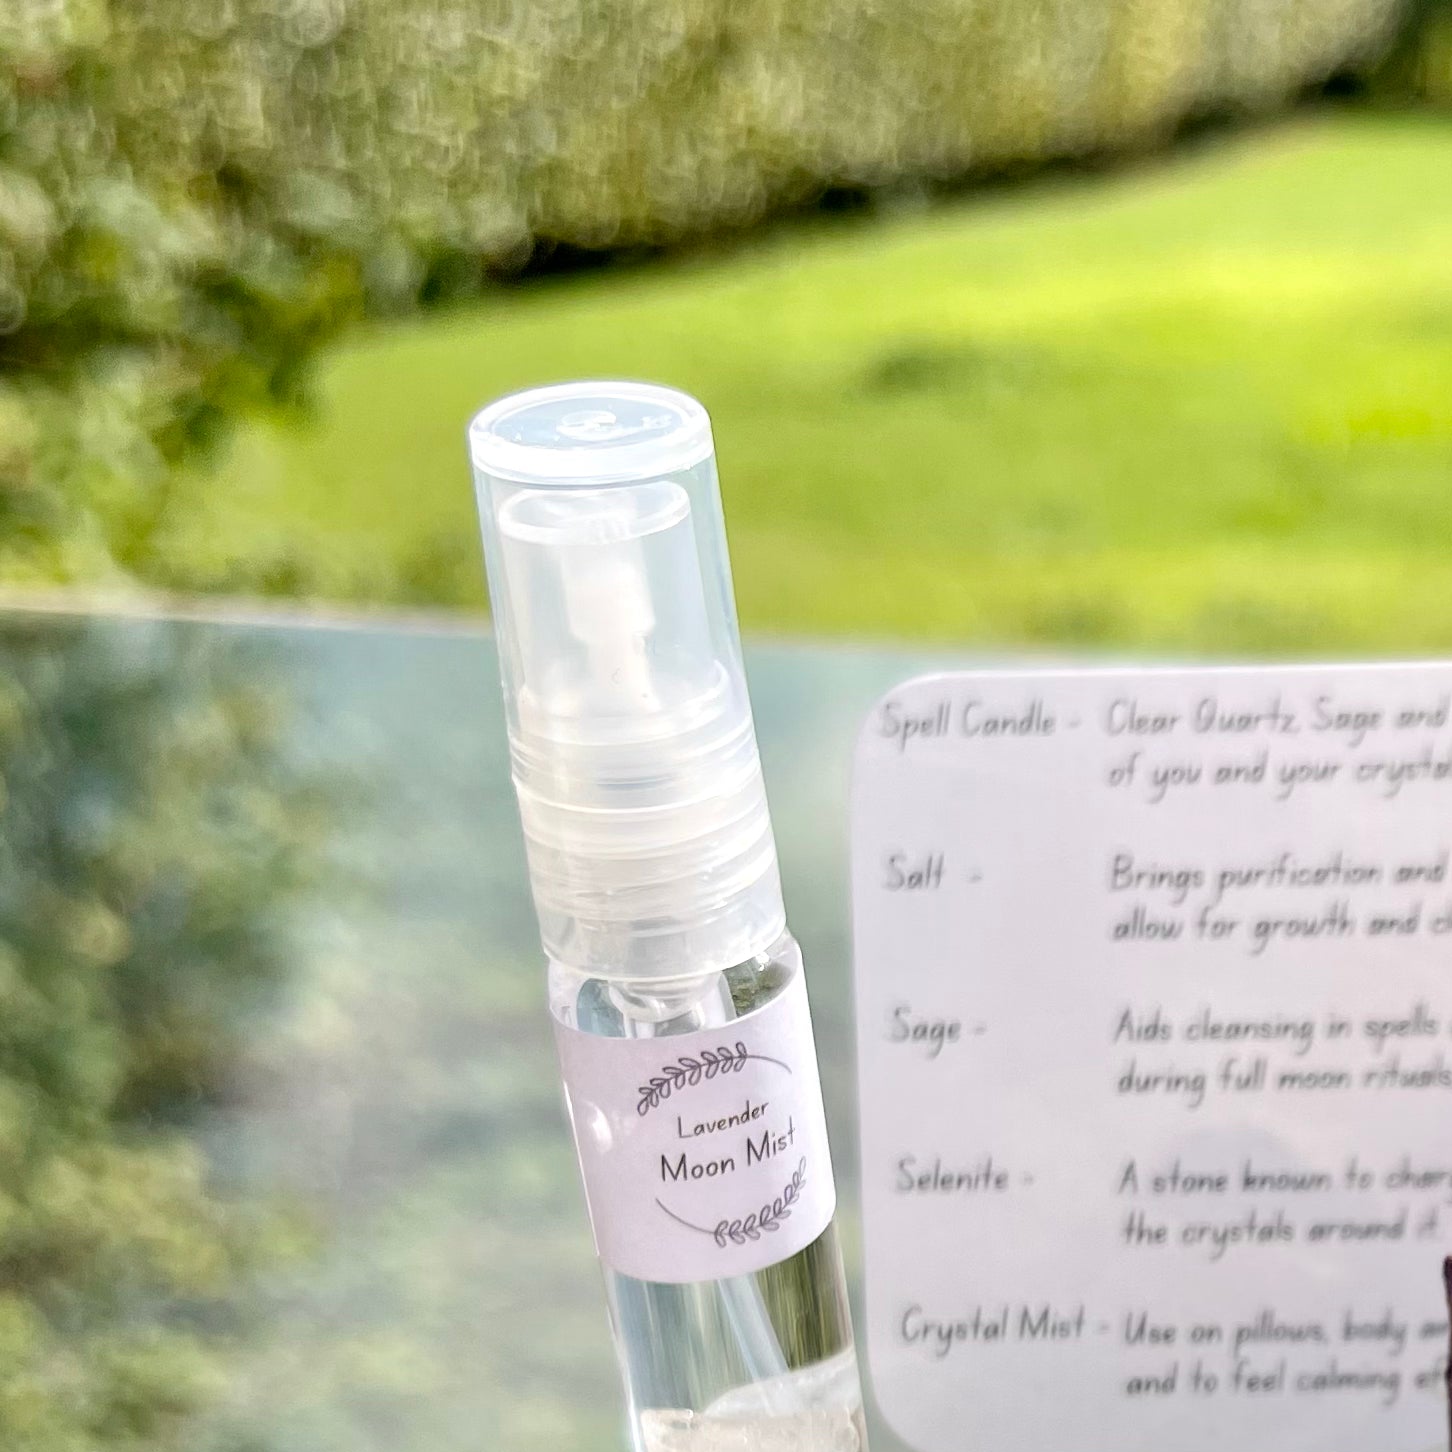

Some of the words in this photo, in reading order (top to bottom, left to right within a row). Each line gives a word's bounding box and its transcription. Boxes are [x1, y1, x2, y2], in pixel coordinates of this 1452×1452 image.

[879, 698, 949, 751] Spell
[961, 696, 1056, 739] Candle
[1107, 698, 1181, 738] Clear
[1311, 693, 1384, 748] Sage
[1397, 690, 1450, 730] and
[1110, 753, 1140, 790] of
[1152, 763, 1203, 803] you
[1215, 747, 1268, 785] and
[1279, 761, 1342, 800] your
[883, 854, 946, 889] Salt
[1111, 852, 1202, 903] Brings
[1219, 850, 1383, 901] purification
[1396, 848, 1448, 884] and
[1113, 905, 1184, 942] allow
[1198, 906, 1238, 940] for
[1255, 902, 1353, 955] growth
[1368, 900, 1420, 936] and
[889, 1004, 963, 1060] Sage
[1114, 1006, 1173, 1043] Aids
[1185, 1006, 1314, 1055] cleansing
[1326, 1008, 1355, 1038] in
[1364, 1002, 1438, 1052] spells
[1118, 1059, 1206, 1108] during
[1220, 1057, 1267, 1089] full
[1279, 1067, 1351, 1089] moon
[678, 1100, 769, 1139] Lavender
[661, 1152, 736, 1182] Moon
[747, 1116, 796, 1167] Mist
[897, 1159, 1009, 1193] Selenite
[1118, 1160, 1140, 1196] A
[1152, 1164, 1227, 1194] stone
[1243, 1158, 1332, 1191] known
[1346, 1157, 1373, 1190] to
[1123, 1210, 1168, 1246] the
[1181, 1208, 1294, 1260] crystals
[1307, 1206, 1406, 1242] around
[901, 1306, 1009, 1361] Crystal
[1019, 1304, 1087, 1339] Mist
[1123, 1313, 1177, 1346] Use
[1191, 1324, 1223, 1343] on
[1344, 1306, 1405, 1355] body
[1419, 1320, 1450, 1338] an
[1126, 1362, 1177, 1395] and
[1192, 1360, 1219, 1394] to
[1232, 1358, 1286, 1393] feel
[1297, 1354, 1401, 1405] calming
